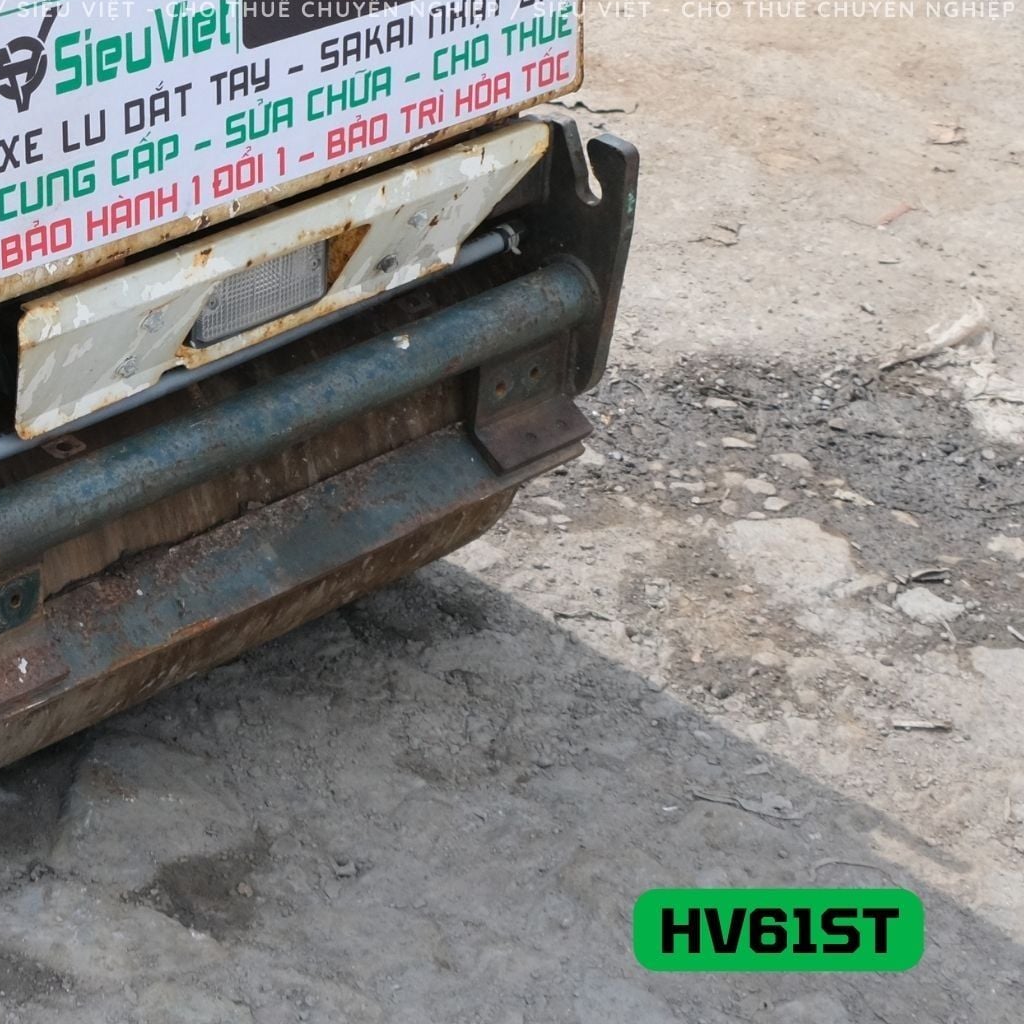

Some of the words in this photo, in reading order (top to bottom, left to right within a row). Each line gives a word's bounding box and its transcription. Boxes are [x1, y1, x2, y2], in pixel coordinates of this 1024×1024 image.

[1, 217, 73, 270] BẢO
[86, 182, 178, 242] HÀNH
[192, 175, 201, 205] 1
[212, 146, 264, 198] ĐỔI
[277, 147, 286, 176] 1
[299, 152, 314, 162] -
[328, 113, 388, 160] BẢO
[400, 89, 444, 133] TRÌ
[455, 72, 511, 117] HỎA
[522, 47, 570, 92] TỐC
[62, 109, 106, 153] LU
[124, 80, 192, 134] DẮT
[210, 58, 270, 105] TAY
[288, 64, 303, 74] -
[320, 16, 414, 73] SAKAI
[111, 132, 179, 187] CẤP
[194, 140, 211, 151] -
[226, 97, 294, 148] SỬA
[307, 66, 392, 122] CHỮA
[404, 72, 421, 83] -
[433, 33, 489, 81] CHO
[501, 0, 573, 56] THUÊ
